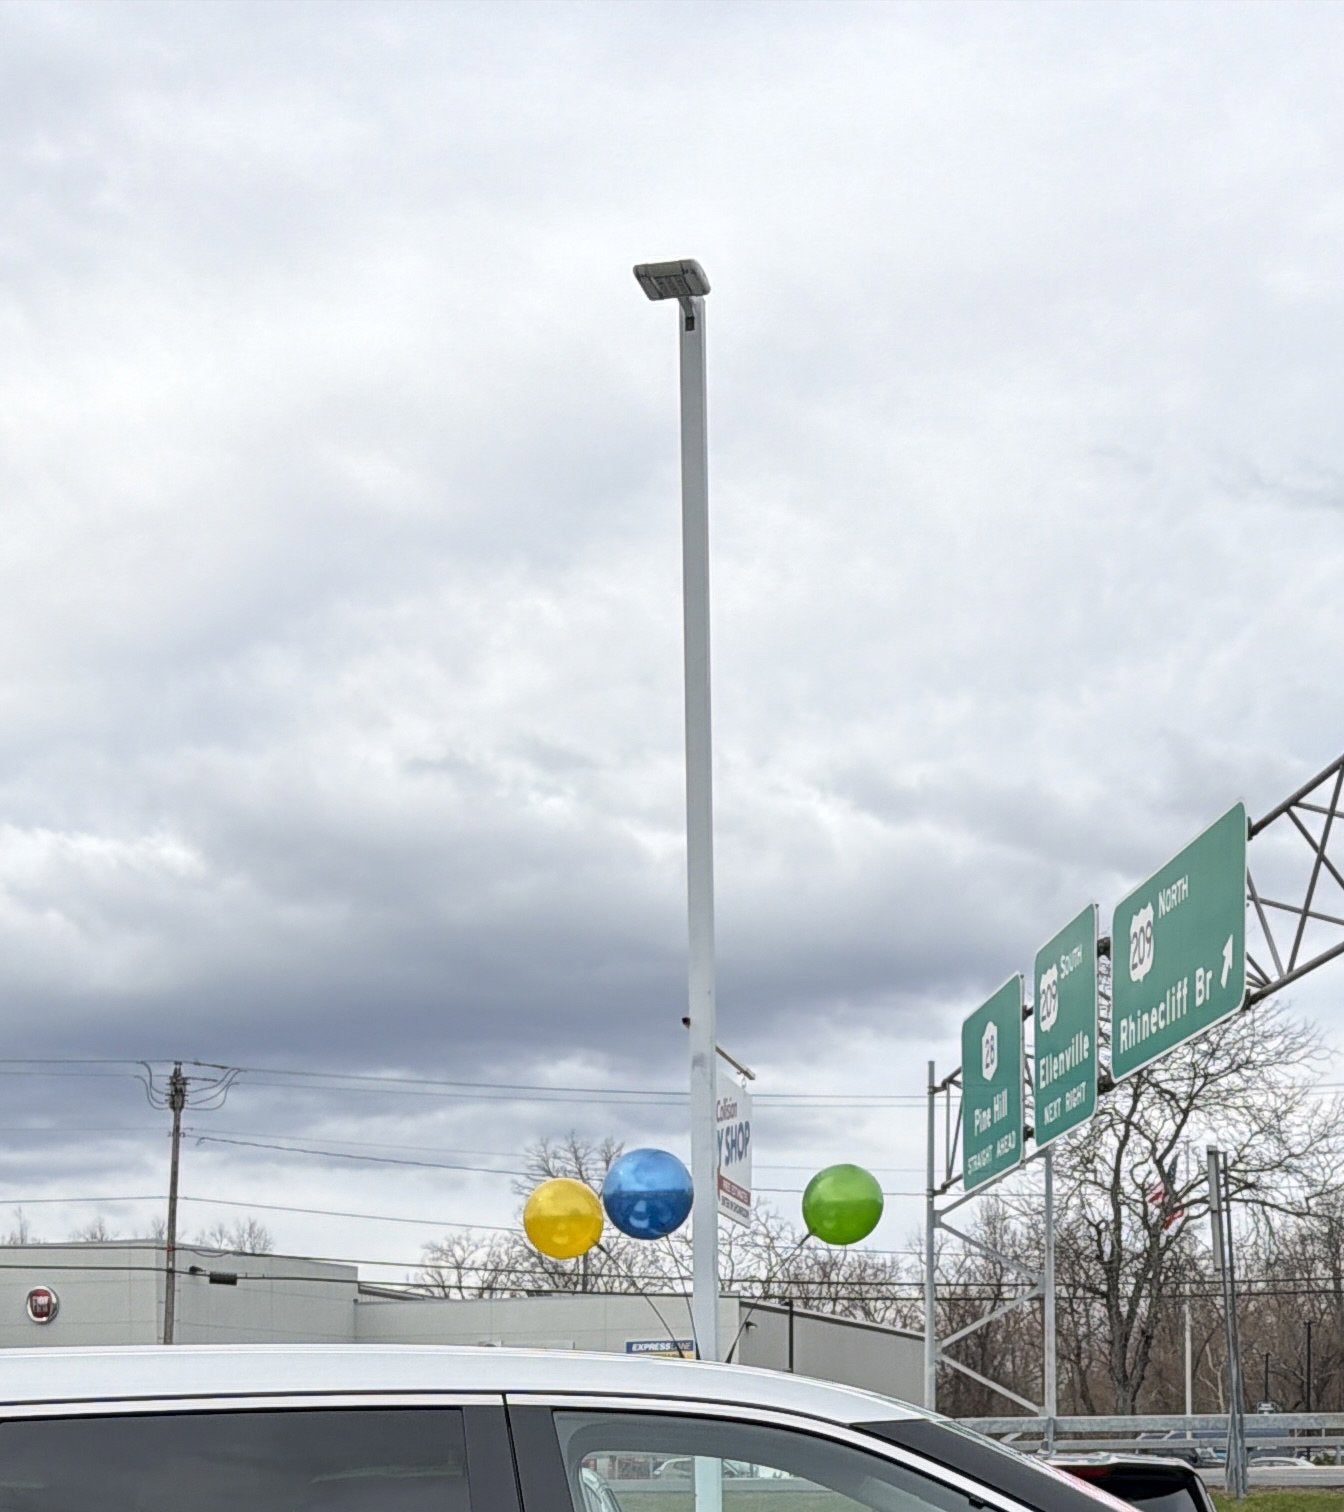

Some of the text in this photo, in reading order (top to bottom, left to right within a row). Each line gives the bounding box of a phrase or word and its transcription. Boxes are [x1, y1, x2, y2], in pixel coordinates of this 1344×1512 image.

[1158, 875, 1189, 919] NORTH
[1060, 944, 1083, 979] SOUTH
[1131, 920, 1153, 972] 209
[1041, 979, 1057, 1023] 209
[1119, 967, 1213, 1054] Rhinecliff Br
[985, 1034, 996, 1069] 28
[1039, 1030, 1090, 1090] Ellenville
[974, 1088, 1008, 1137] Pine Hill
[1044, 1081, 1087, 1126] NEXT RIGHT
[724, 1120, 751, 1167] SHOP
